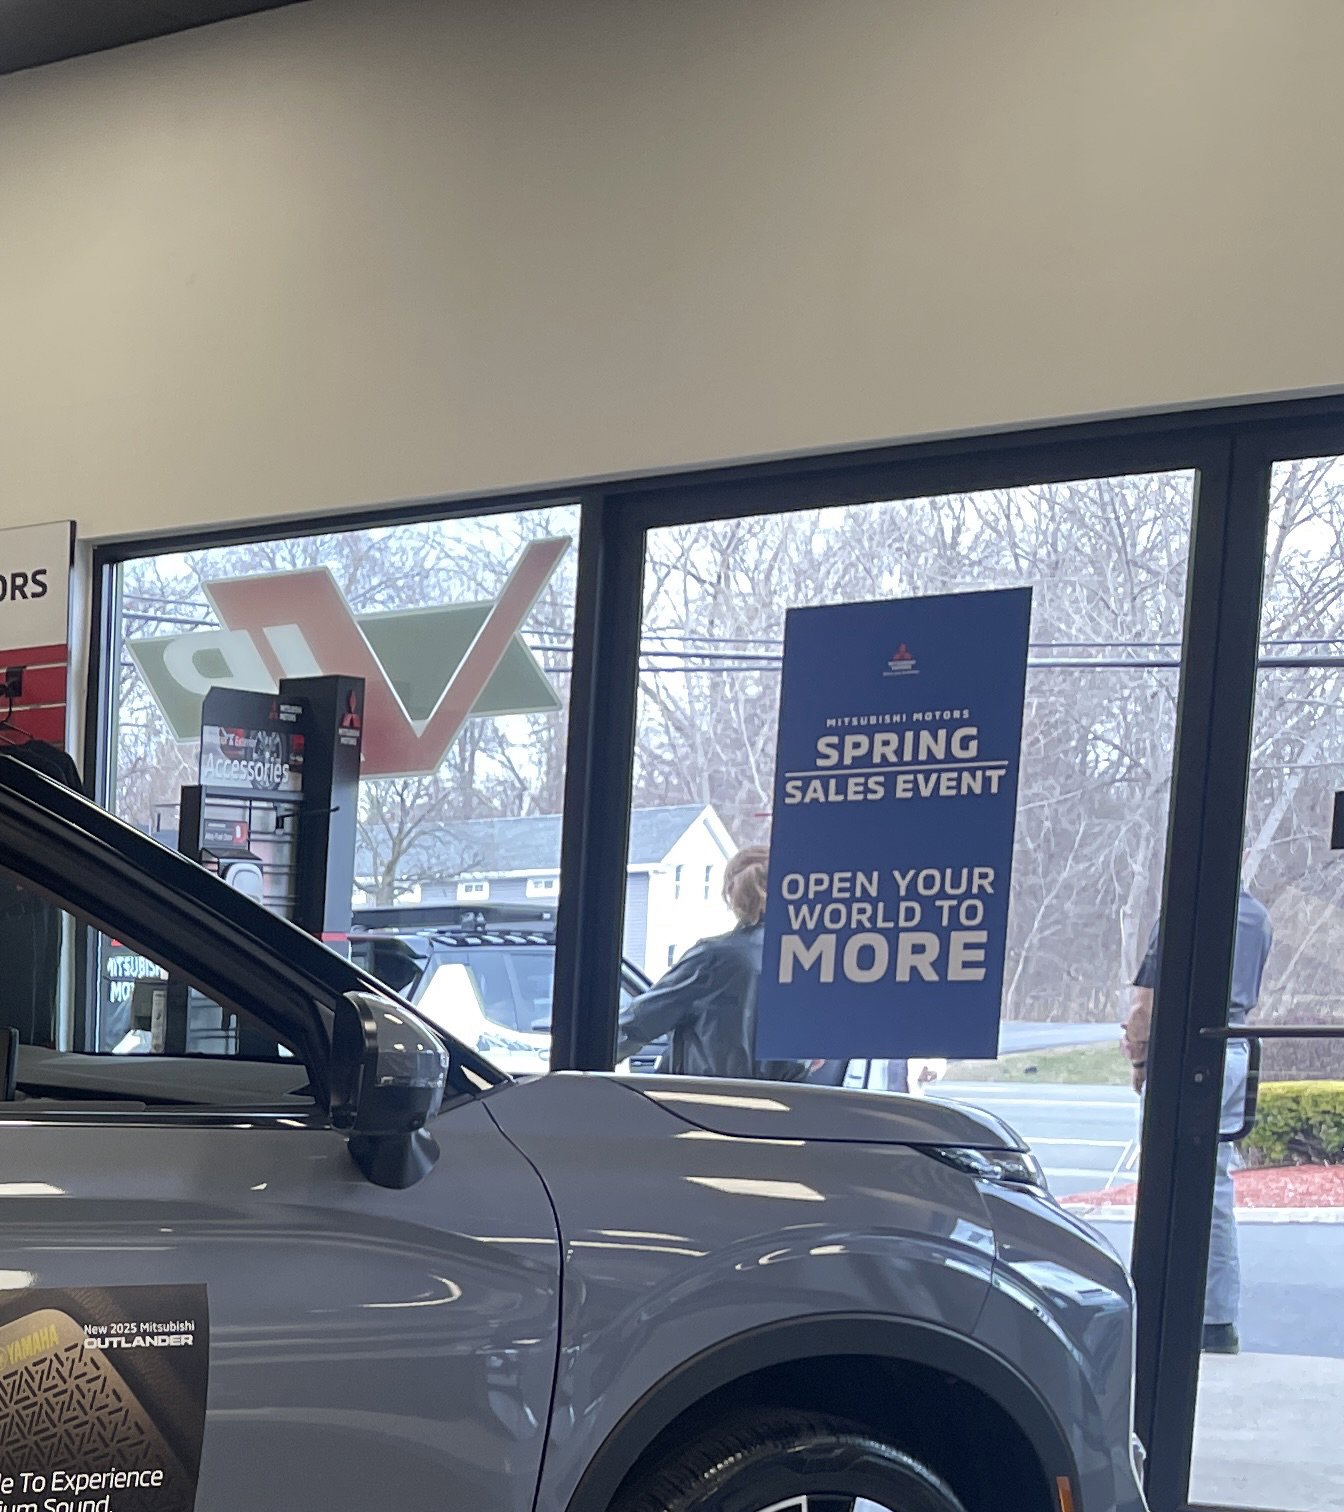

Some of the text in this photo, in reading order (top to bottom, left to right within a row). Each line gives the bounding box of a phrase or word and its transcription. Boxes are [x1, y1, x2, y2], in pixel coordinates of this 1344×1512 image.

[826, 709, 970, 727] MITSUBISHI MOTORS
[815, 727, 978, 767] SPRING
[205, 752, 290, 783] Accessories
[784, 768, 1007, 805] SALES EVENT
[781, 867, 995, 900] OPEN YOUR
[787, 899, 984, 930] WORLD TO
[778, 930, 989, 984] MORE
[83, 1320, 195, 1335] New 2025 Mitsubishi
[83, 1334, 194, 1350] OUTLANDER
[6, 1323, 60, 1364] YAMAHA
[20, 1472, 46, 1494] To
[51, 1467, 163, 1495] Experience
